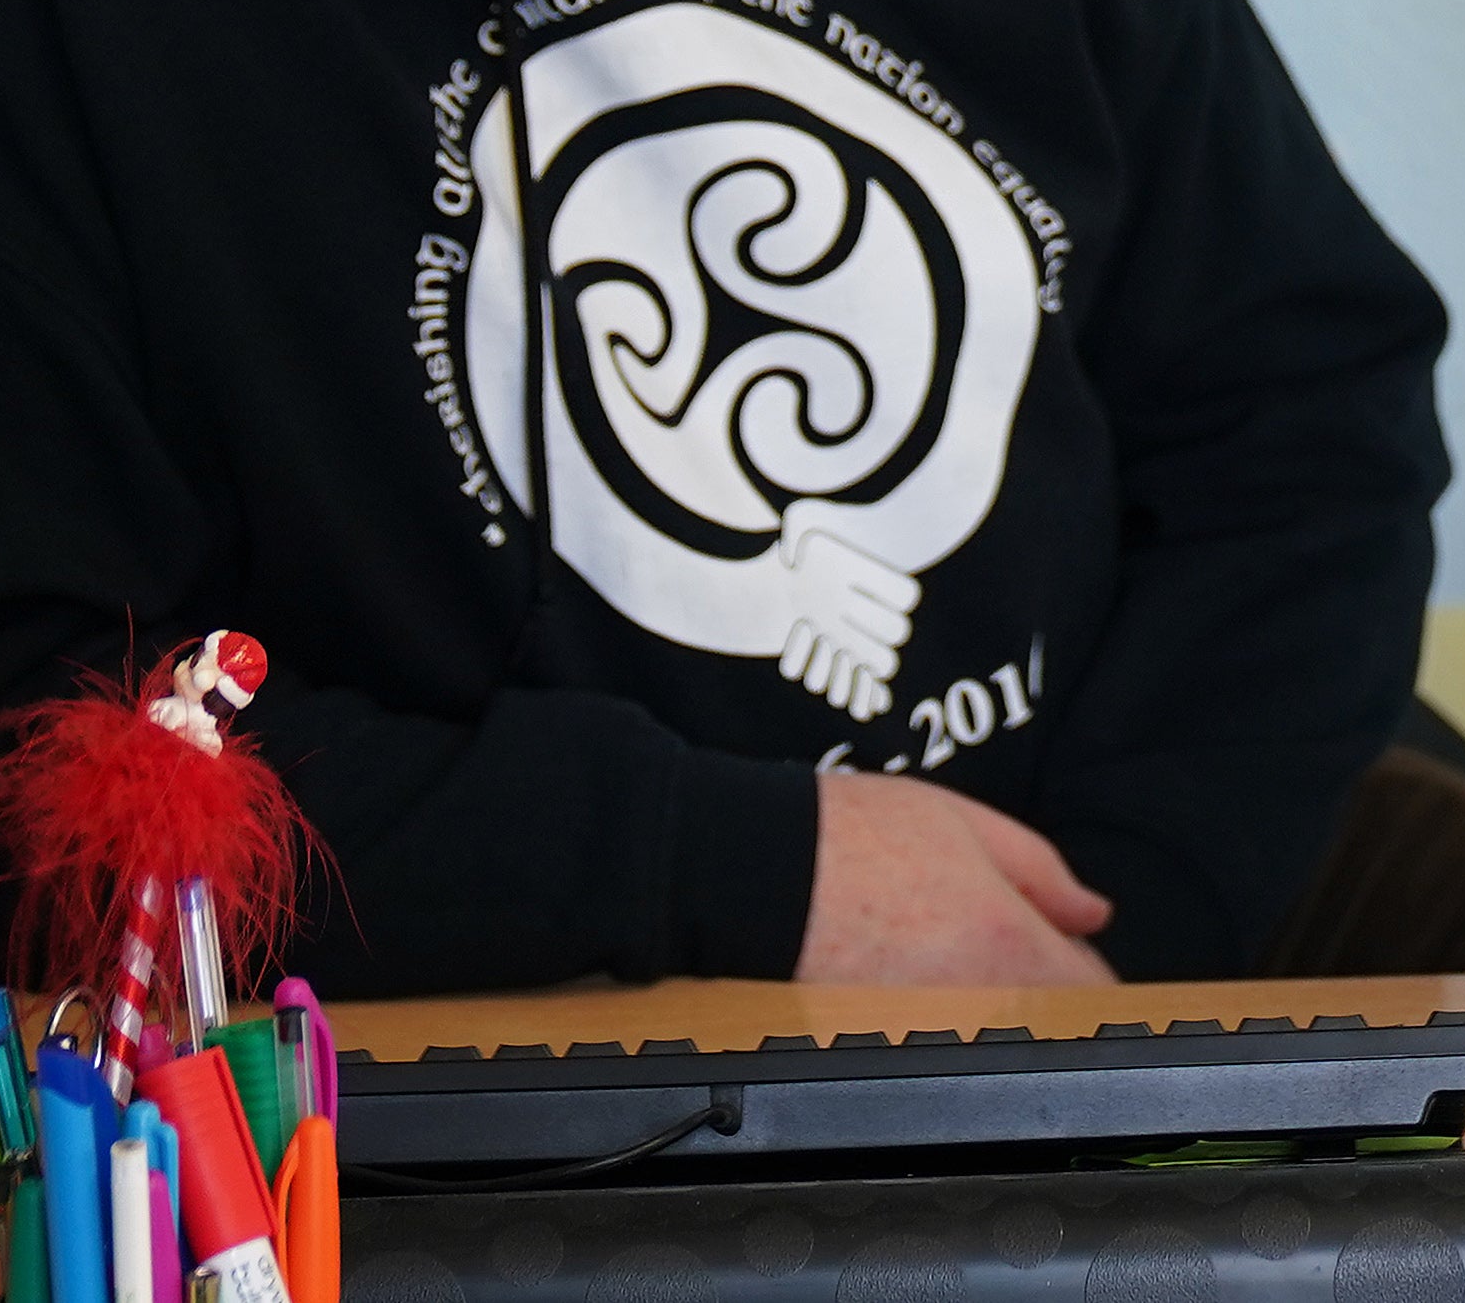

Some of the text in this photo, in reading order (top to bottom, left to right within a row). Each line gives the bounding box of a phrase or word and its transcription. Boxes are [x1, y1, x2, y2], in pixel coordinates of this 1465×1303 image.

[407, 233, 504, 513] cherishing
[826, 11, 964, 137] nation
[908, 631, 1047, 772] 201
